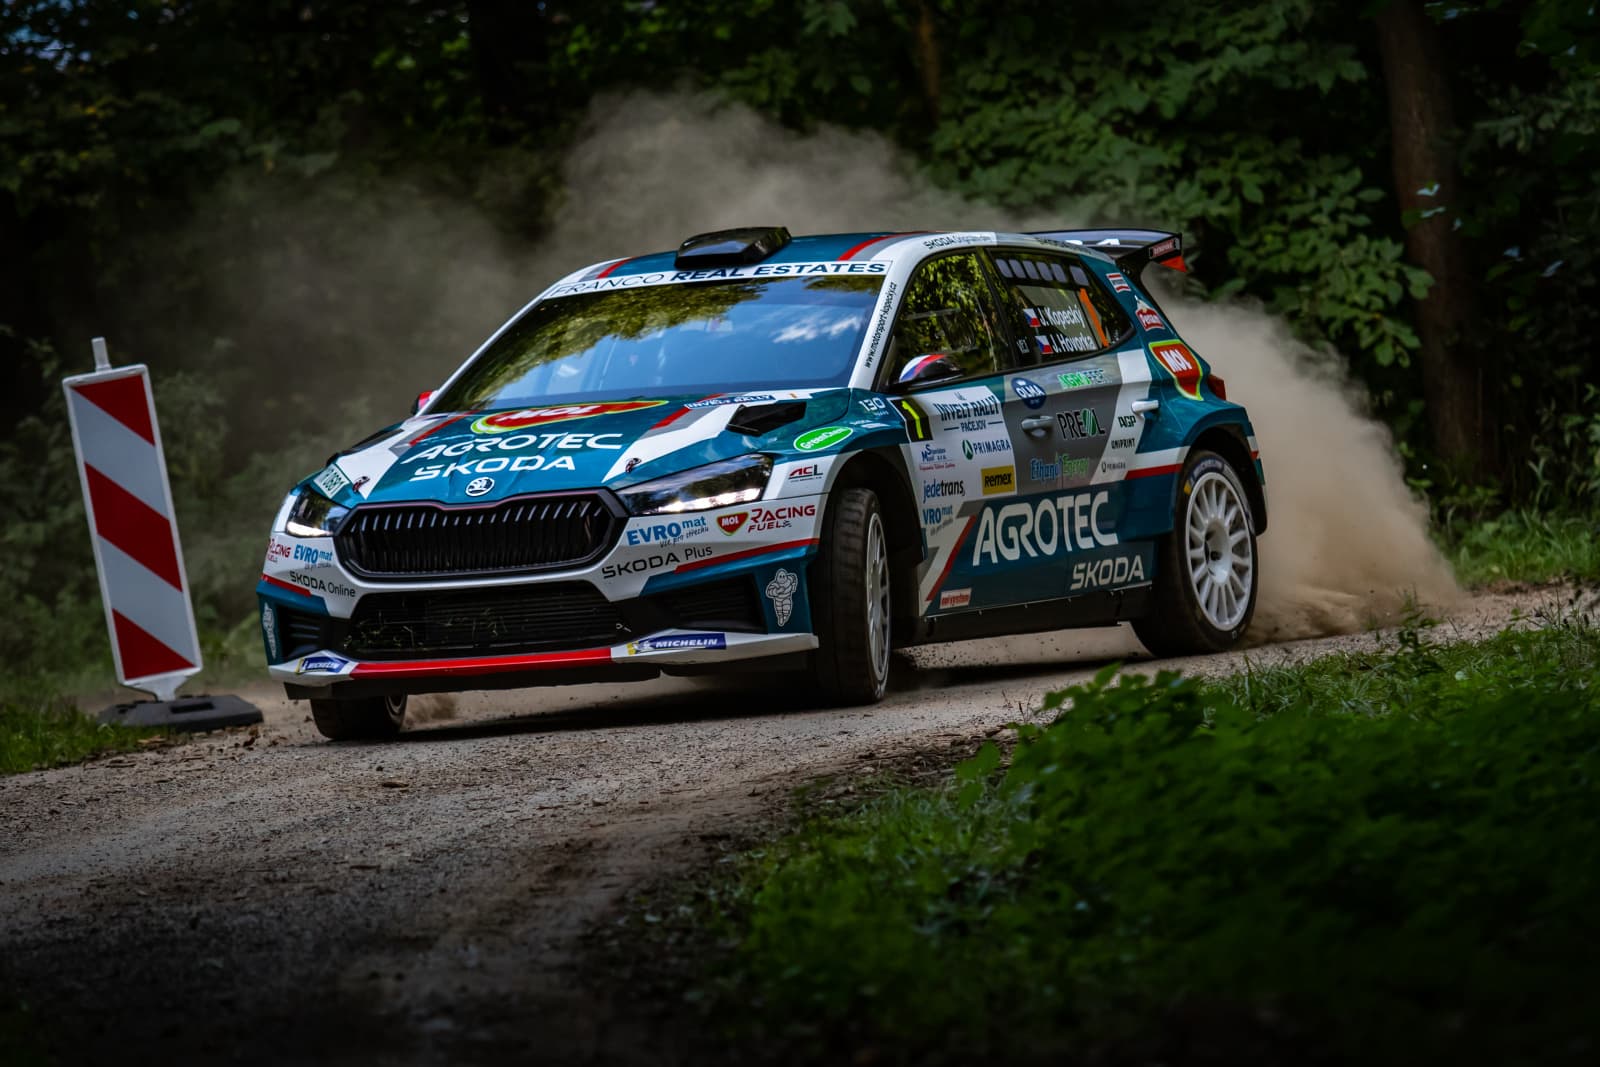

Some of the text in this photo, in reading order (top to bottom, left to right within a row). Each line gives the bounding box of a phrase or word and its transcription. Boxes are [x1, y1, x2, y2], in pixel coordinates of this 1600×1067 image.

[554, 262, 886, 298] FRANCO REAL ESTATES
[1055, 333, 1099, 352] Hovorka
[1159, 348, 1193, 373] MOL
[1015, 384, 1046, 399] OLMA
[859, 397, 886, 412] 130
[933, 394, 1000, 421] INVELT RALLY
[400, 432, 624, 465] AGROTEC
[972, 439, 1011, 455] PRIMAGRA
[789, 464, 824, 477] ACL
[721, 515, 740, 526] MOL
[751, 504, 816, 523] RACING
[972, 490, 1119, 567] AGROTEC
[685, 545, 713, 561] Plus
[327, 582, 356, 597] Online
[655, 638, 719, 648] MICHELIN
